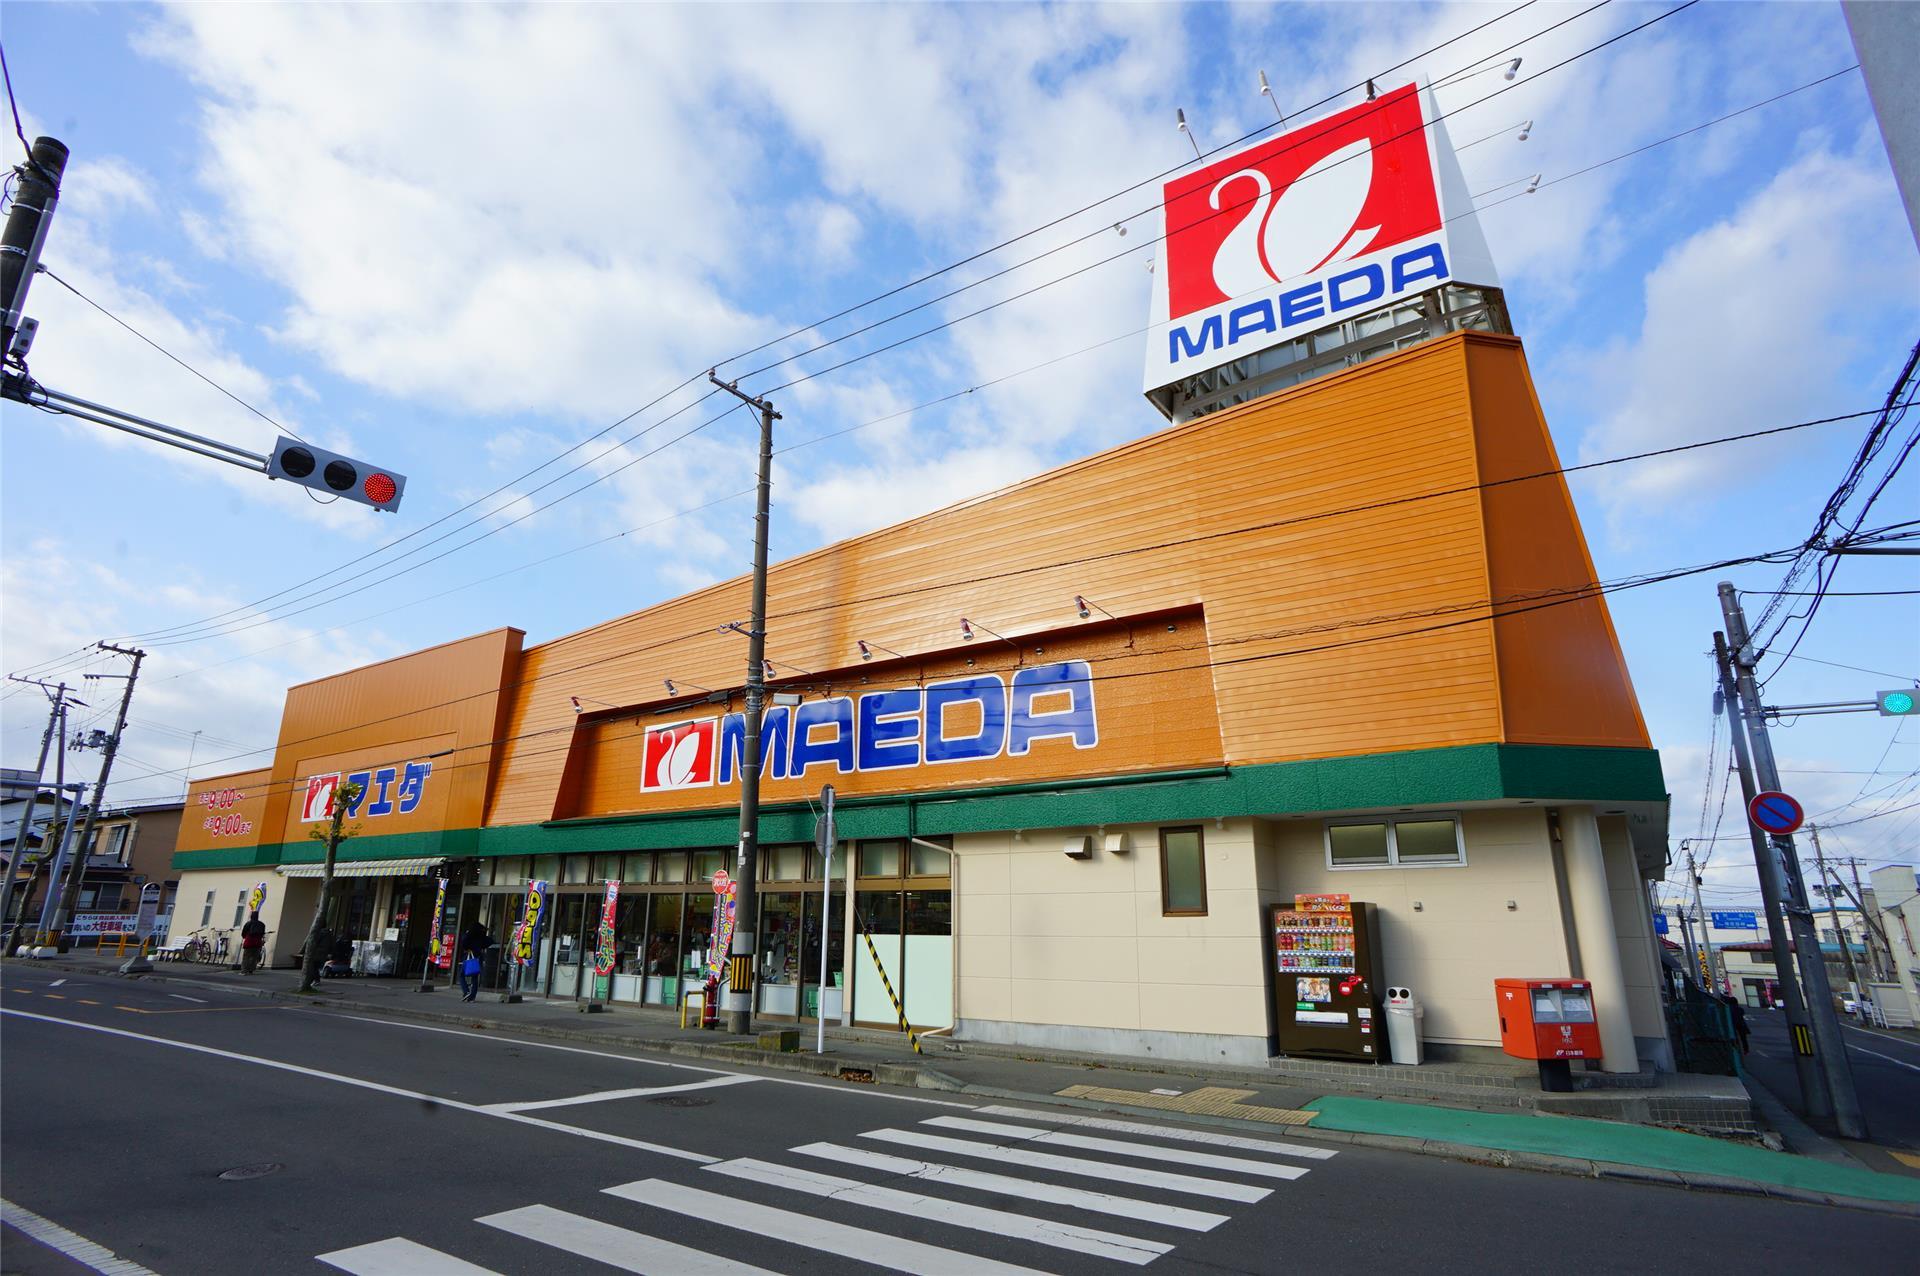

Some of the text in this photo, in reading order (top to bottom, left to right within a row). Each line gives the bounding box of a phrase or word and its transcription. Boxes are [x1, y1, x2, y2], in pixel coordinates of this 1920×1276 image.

[1169, 242, 1450, 364] MAEDA
[717, 659, 1099, 786] MAEDA
[346, 761, 433, 820] マエダ
